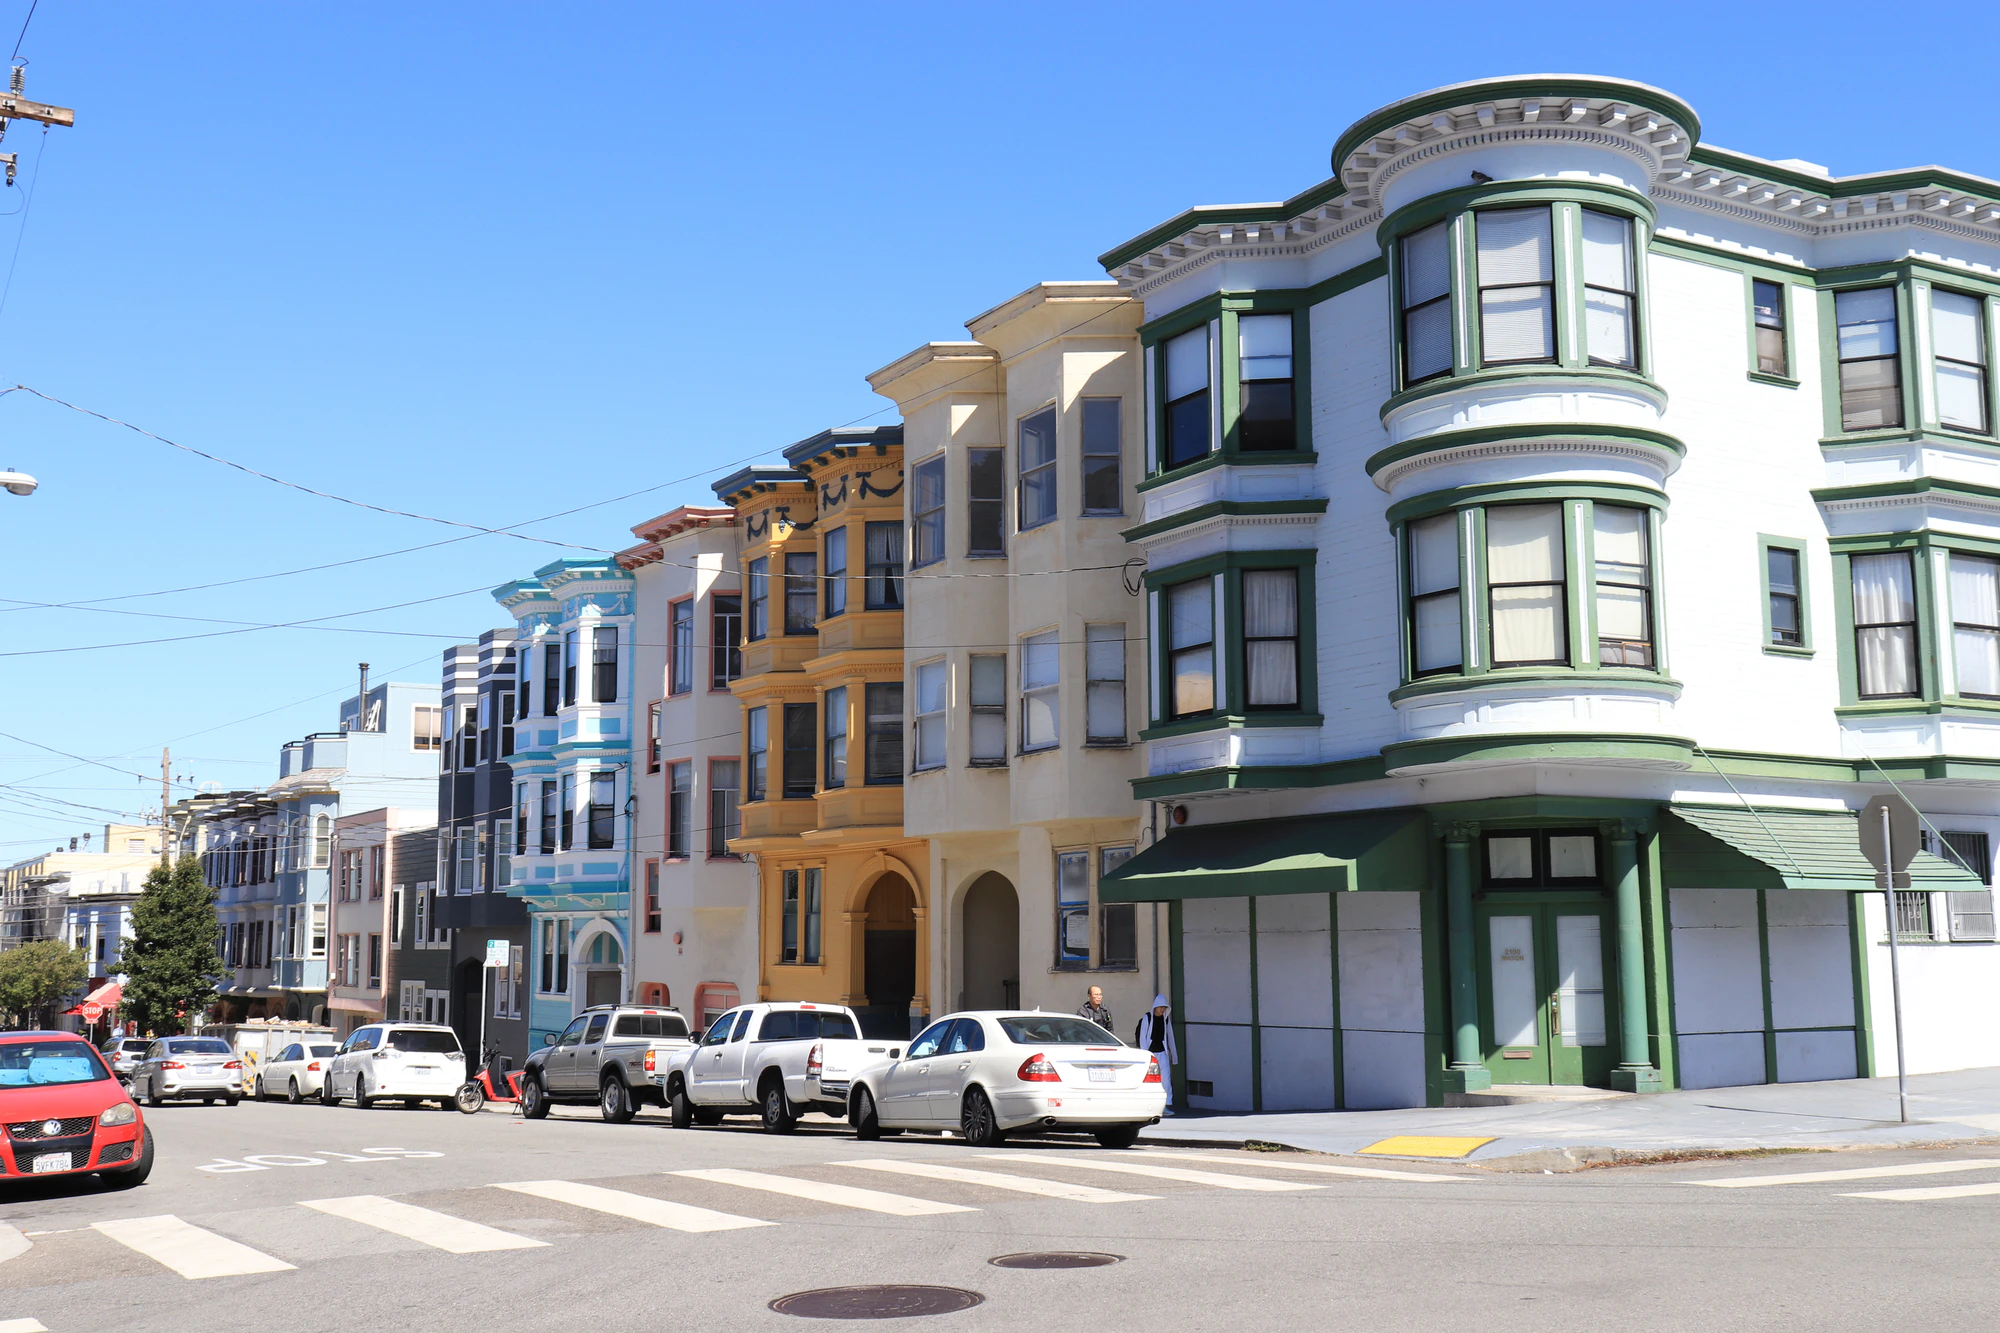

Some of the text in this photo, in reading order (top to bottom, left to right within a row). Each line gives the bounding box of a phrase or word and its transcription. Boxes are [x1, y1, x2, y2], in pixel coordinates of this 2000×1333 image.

[84, 1006, 101, 1015] STOP
[35, 1159, 69, 1171] 5VFK784
[194, 1147, 445, 1173] STOP
